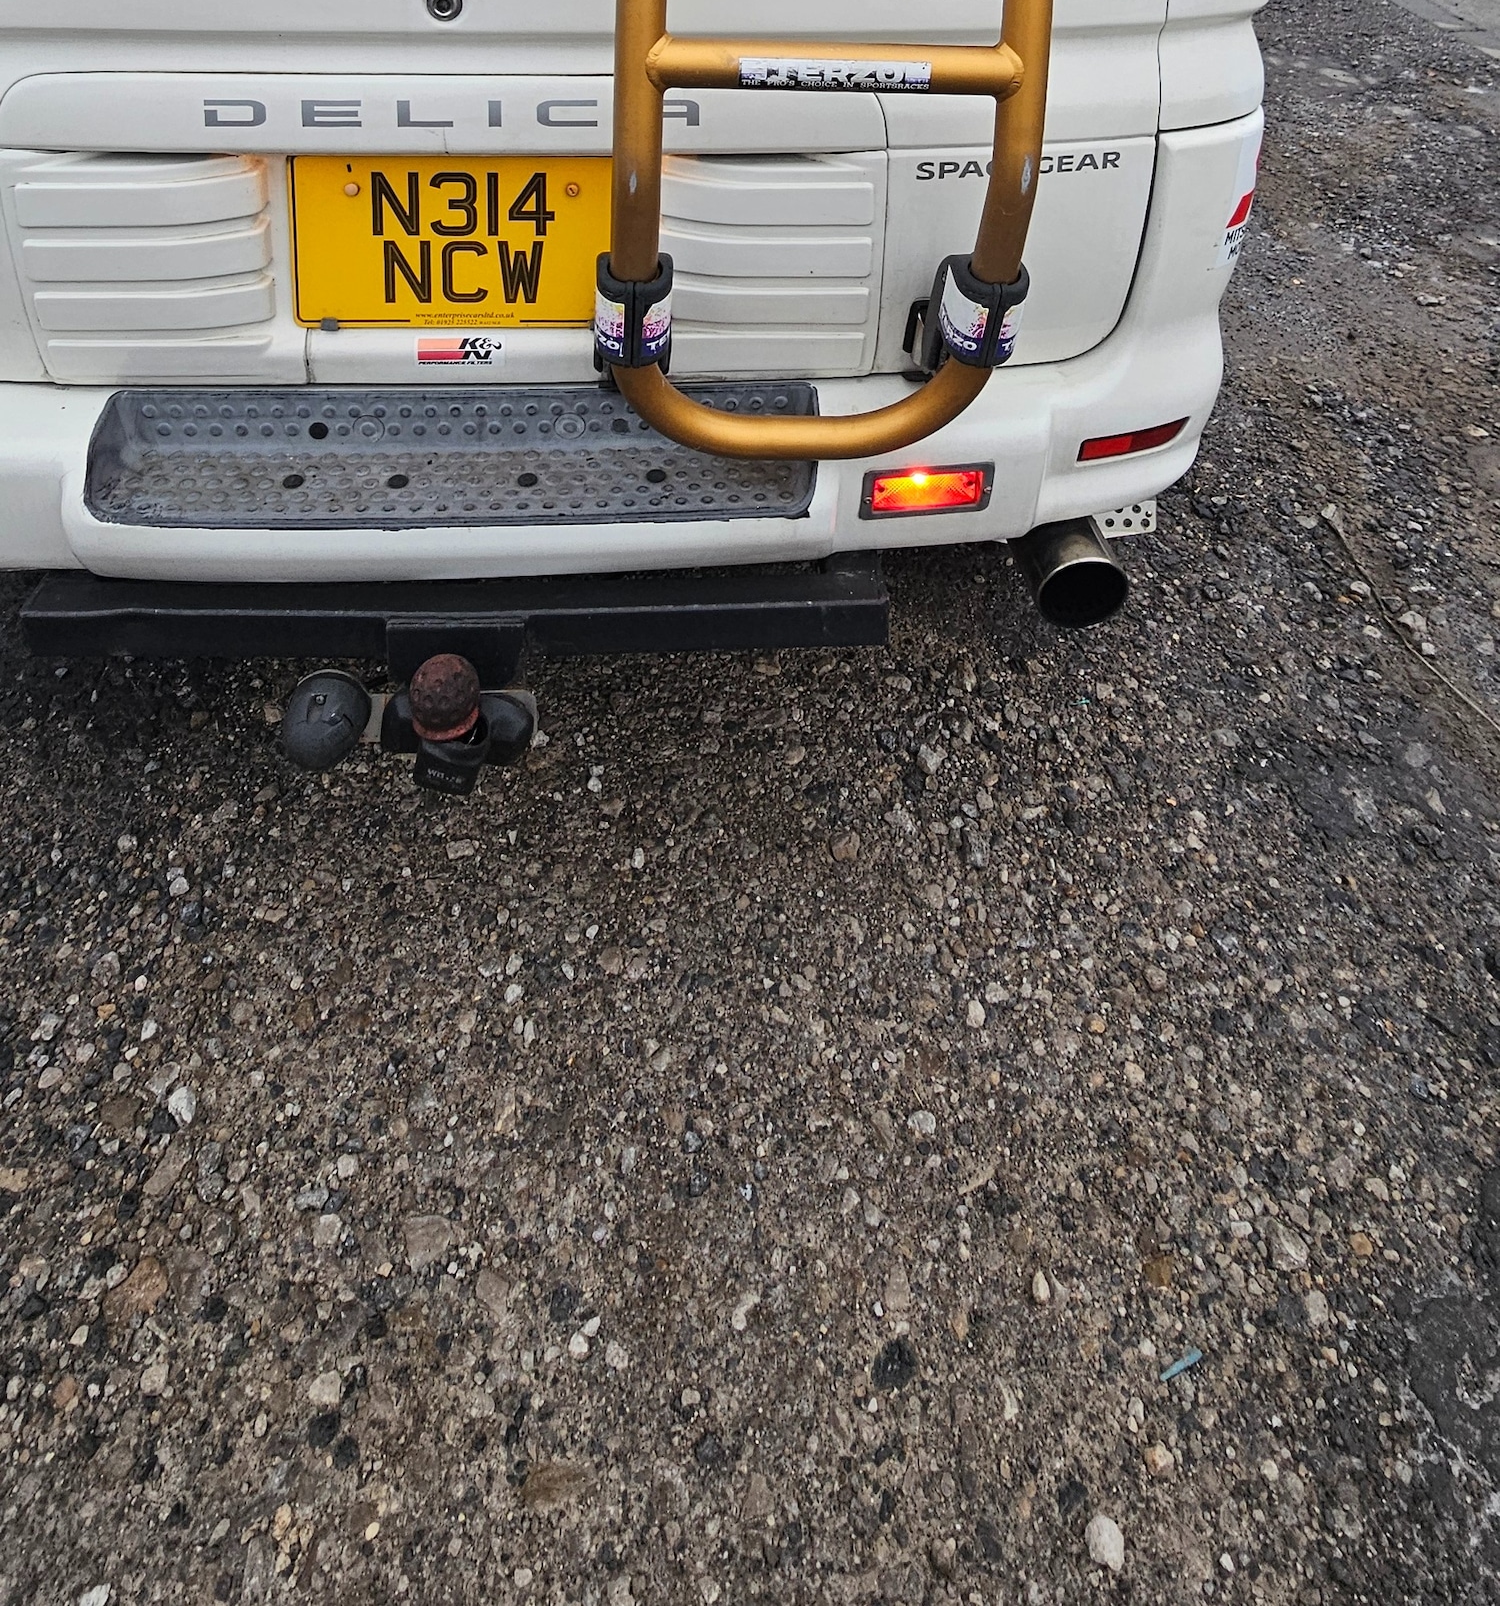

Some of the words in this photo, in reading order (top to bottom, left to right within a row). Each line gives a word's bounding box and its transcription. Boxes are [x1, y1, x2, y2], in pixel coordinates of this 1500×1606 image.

[766, 79, 796, 87] PRO'S
[860, 82, 930, 90] SPORTSRACKS
[203, 99, 699, 128] DELICA
[915, 160, 993, 181] SPA
[371, 172, 554, 236] N314
[383, 240, 544, 303] NCW
